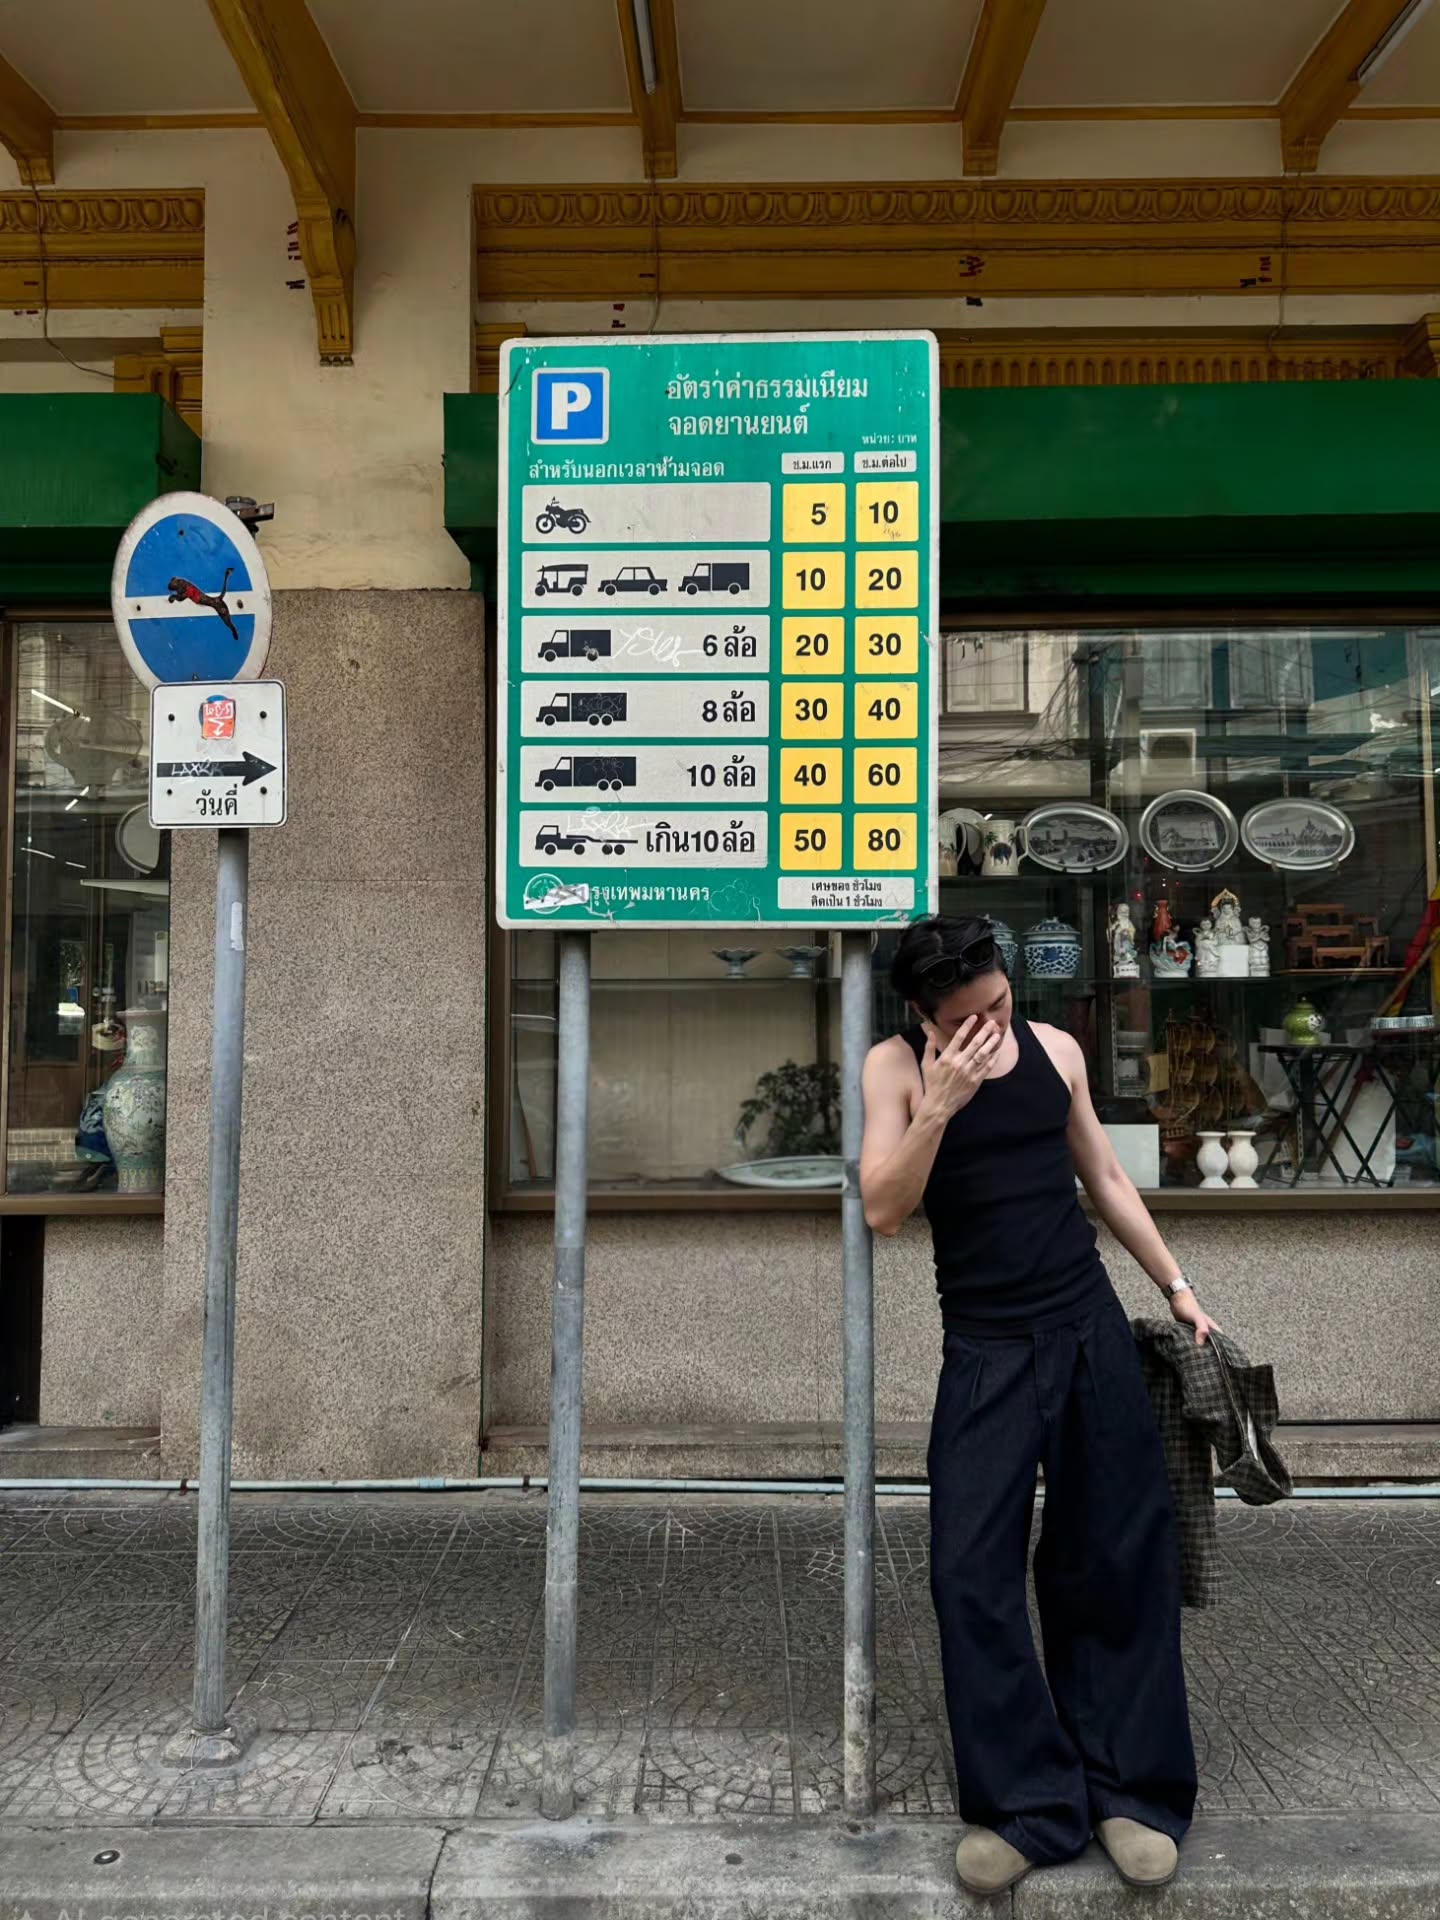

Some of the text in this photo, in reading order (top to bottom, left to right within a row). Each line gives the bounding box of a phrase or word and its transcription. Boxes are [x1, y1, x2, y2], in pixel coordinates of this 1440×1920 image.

[551, 382, 592, 430] P
[668, 402, 811, 435] จอดยานยนต์
[529, 456, 725, 479] สำหรับนอกเวลาห้ามจอด
[811, 502, 827, 525] 5
[868, 500, 899, 524] 10
[796, 567, 826, 591] 10
[868, 567, 902, 591] 20
[703, 634, 718, 657] 6
[724, 624, 757, 657] ล้อ
[796, 633, 829, 656] 20
[868, 632, 902, 656] 30
[702, 690, 756, 723] 8 ล้อ
[795, 698, 828, 721] 30
[868, 697, 901, 721] 40
[686, 754, 756, 787] 10 ล้อ
[794, 763, 827, 786] 40
[868, 763, 901, 786] 60
[195, 783, 238, 816] วันคี่
[794, 828, 827, 852] 50
[868, 828, 901, 852] 80
[591, 885, 710, 906] รุงเทพมหานคร
[846, 896, 850, 907] 1
